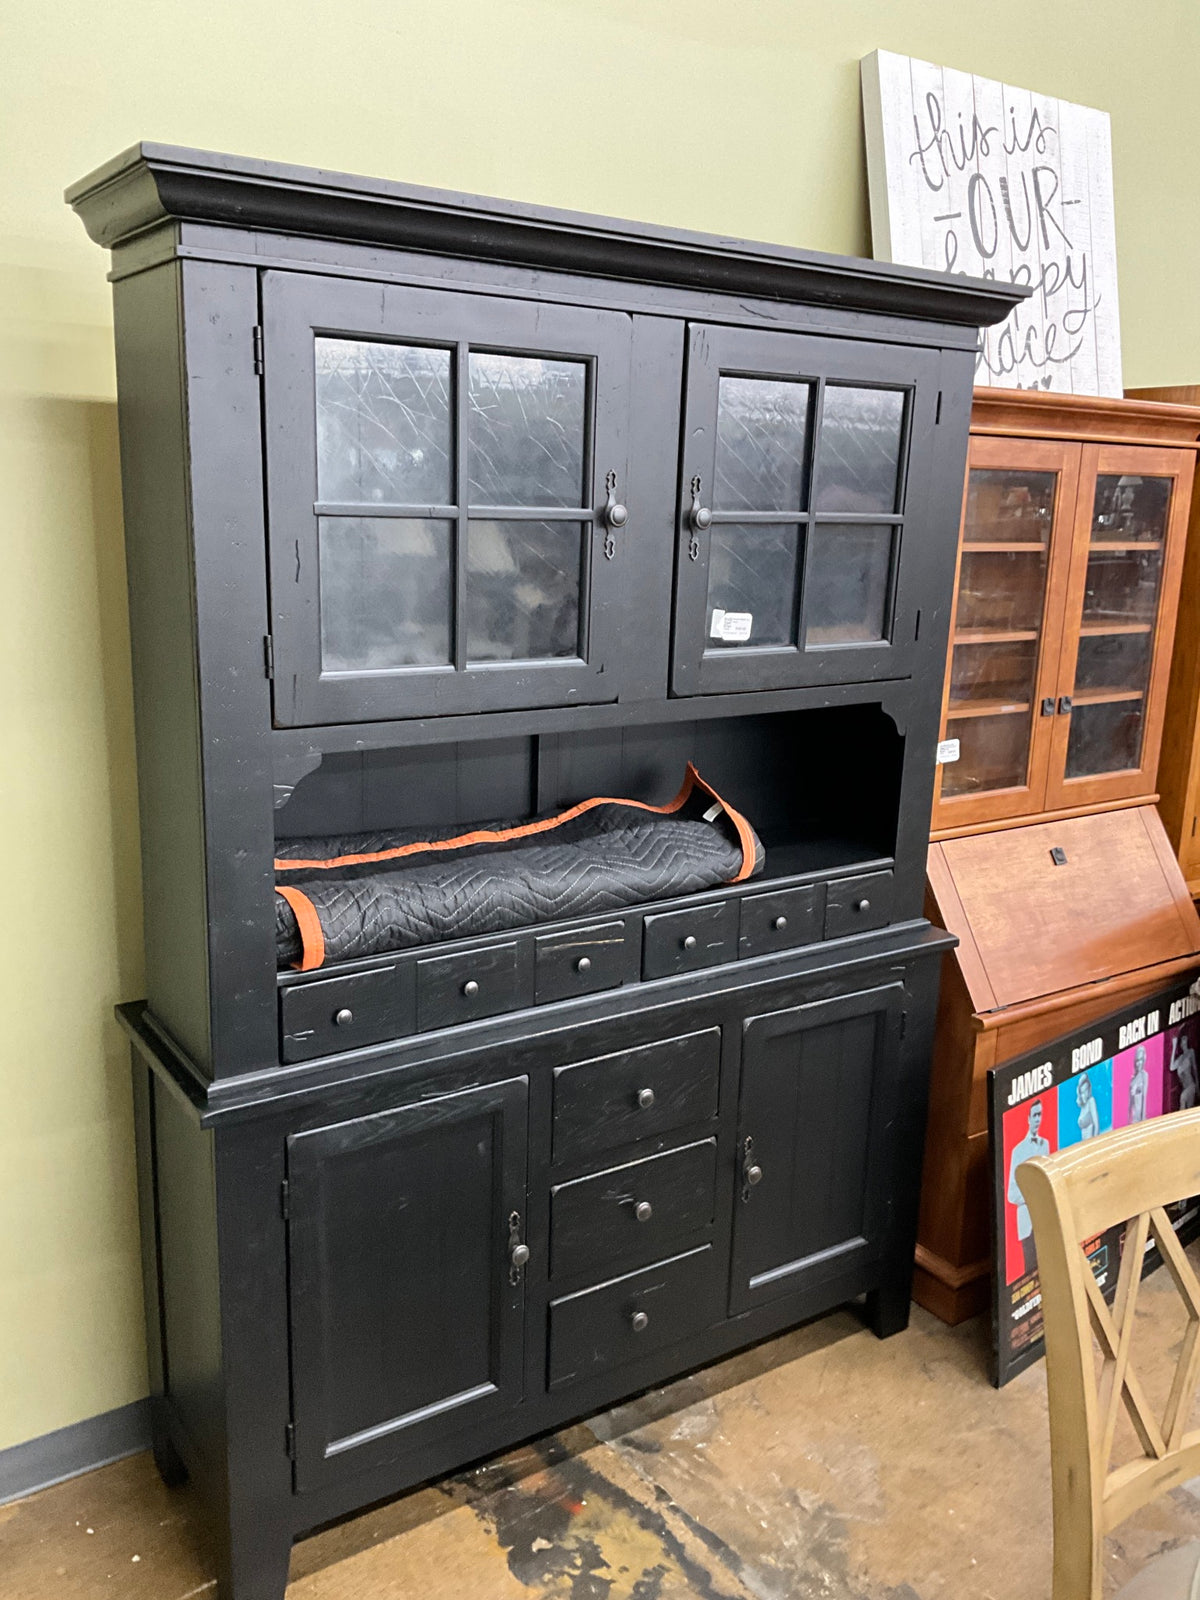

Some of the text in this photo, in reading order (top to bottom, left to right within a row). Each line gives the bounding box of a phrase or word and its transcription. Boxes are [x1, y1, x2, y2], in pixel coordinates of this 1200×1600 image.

[909, 92, 1058, 192] this is
[1007, 1061, 1054, 1107] JAMES
[1071, 1037, 1104, 1074] BOND
[1118, 1015, 1146, 1051] BACK
[1147, 1009, 1161, 1037] IN
